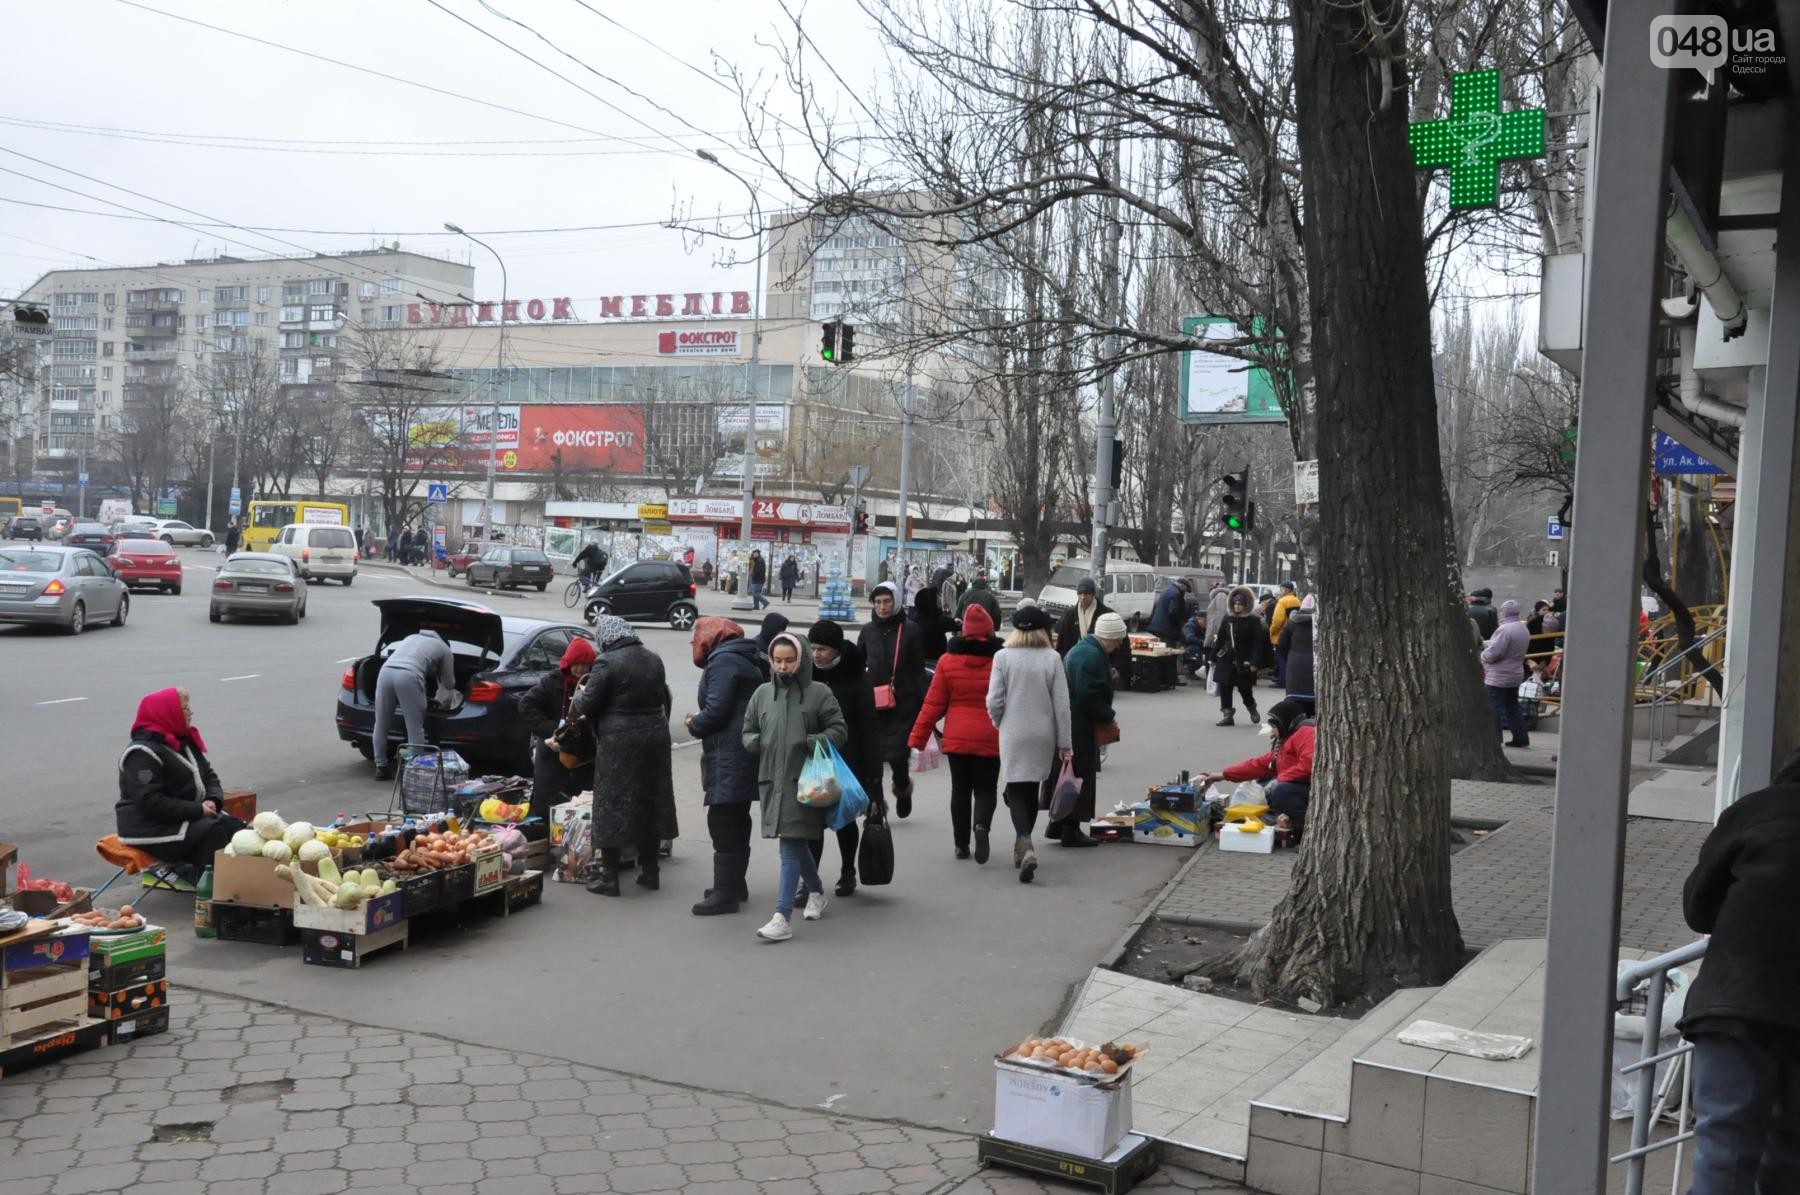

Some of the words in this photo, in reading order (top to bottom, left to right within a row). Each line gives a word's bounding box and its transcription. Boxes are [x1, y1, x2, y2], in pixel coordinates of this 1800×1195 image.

[406, 297, 573, 326] БУДИНОК
[600, 291, 751, 318] МЕБЛІВ
[15, 326, 53, 336] ТРАМВАЙ
[679, 331, 738, 345] ФОКСТРОТ
[476, 412, 518, 431] МЕЕЛЬ
[552, 430, 634, 448] ФОКСТРОТ
[1663, 457, 1677, 468] ул.
[1680, 456, 1695, 466] Ак.
[757, 501, 774, 514] 24
